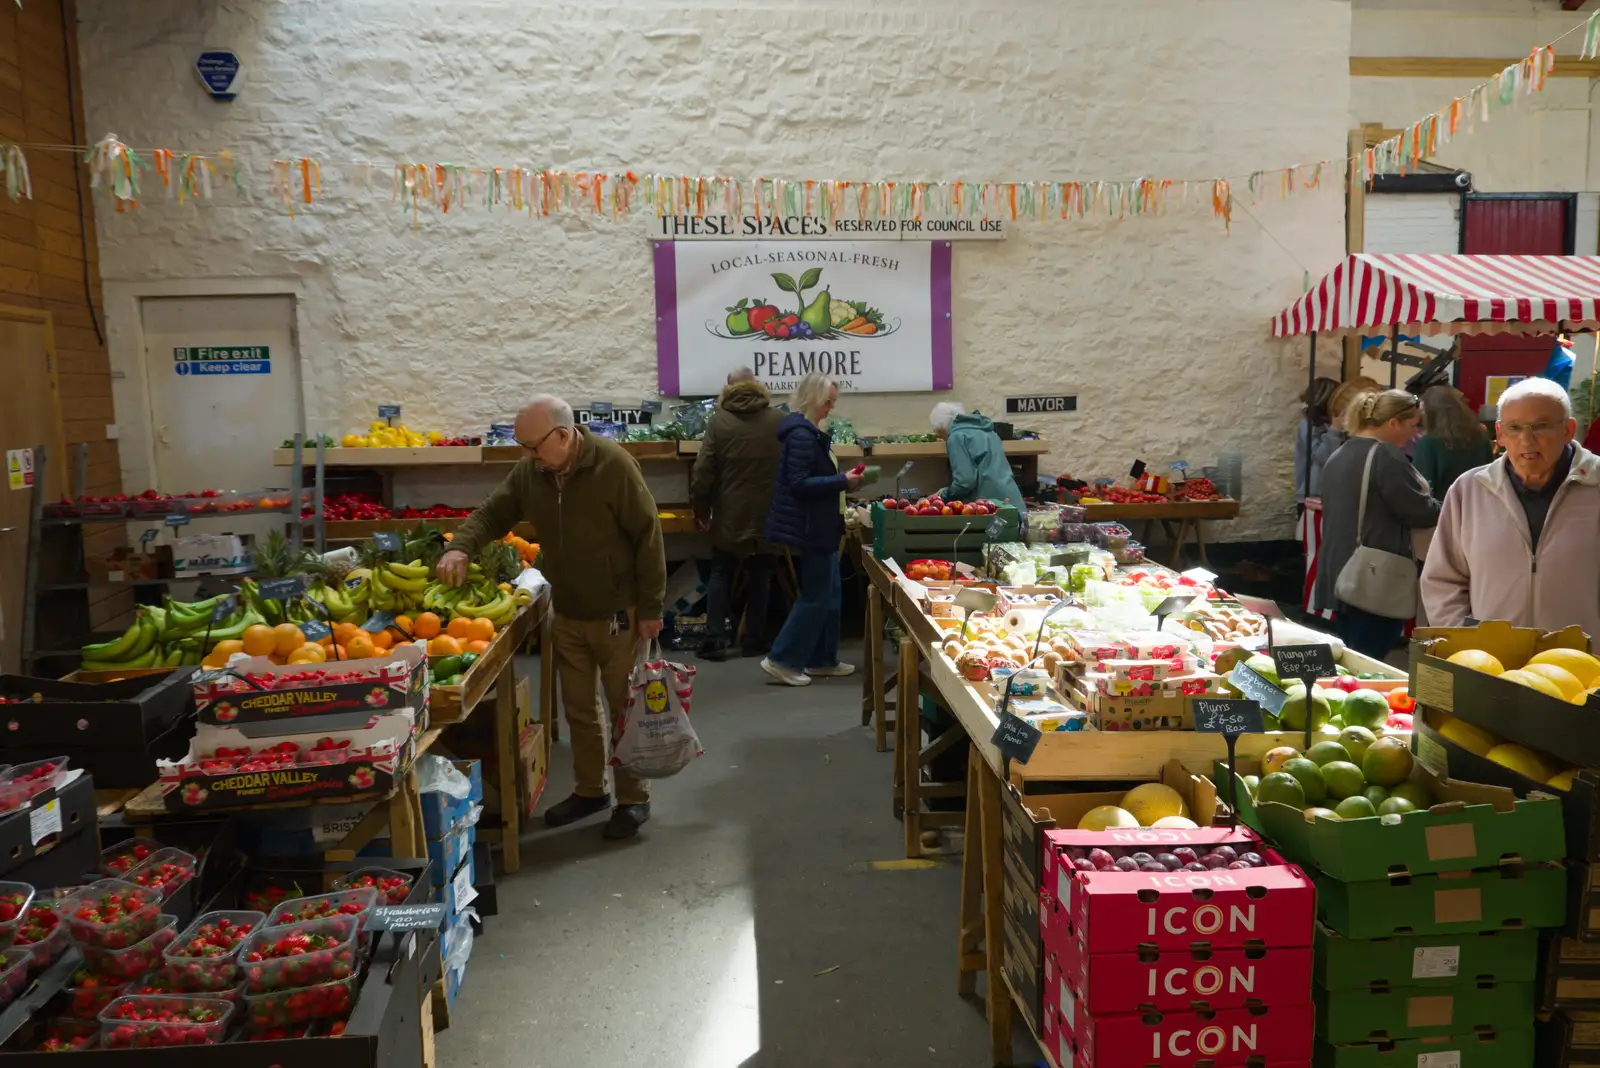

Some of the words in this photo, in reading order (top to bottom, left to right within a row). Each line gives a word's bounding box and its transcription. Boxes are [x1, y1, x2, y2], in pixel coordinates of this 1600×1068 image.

[661, 214, 734, 235] THESE
[742, 214, 828, 235] SPACES
[835, 219, 897, 232] RESERVED
[901, 219, 923, 232] FOR
[926, 219, 976, 232] COUNCIL
[980, 219, 1003, 232] USE
[198, 347, 229, 360] Fire
[232, 346, 262, 360] exit
[200, 362, 230, 374] Keep
[233, 361, 262, 372] clear
[753, 350, 862, 377] PEAMORE
[1017, 397, 1065, 412] MAYOR
[241, 692, 295, 709] CHEDDAR
[295, 692, 338, 705] VALLEY
[1199, 701, 1231, 714] Plums
[211, 772, 270, 791] CHEDDAR
[271, 772, 319, 785] VALLEY
[1112, 832, 1193, 842] ICON
[1149, 873, 1238, 888] ICON
[1147, 904, 1256, 936] ICON
[1147, 965, 1256, 997] ICON
[1152, 1023, 1258, 1059] ICON
